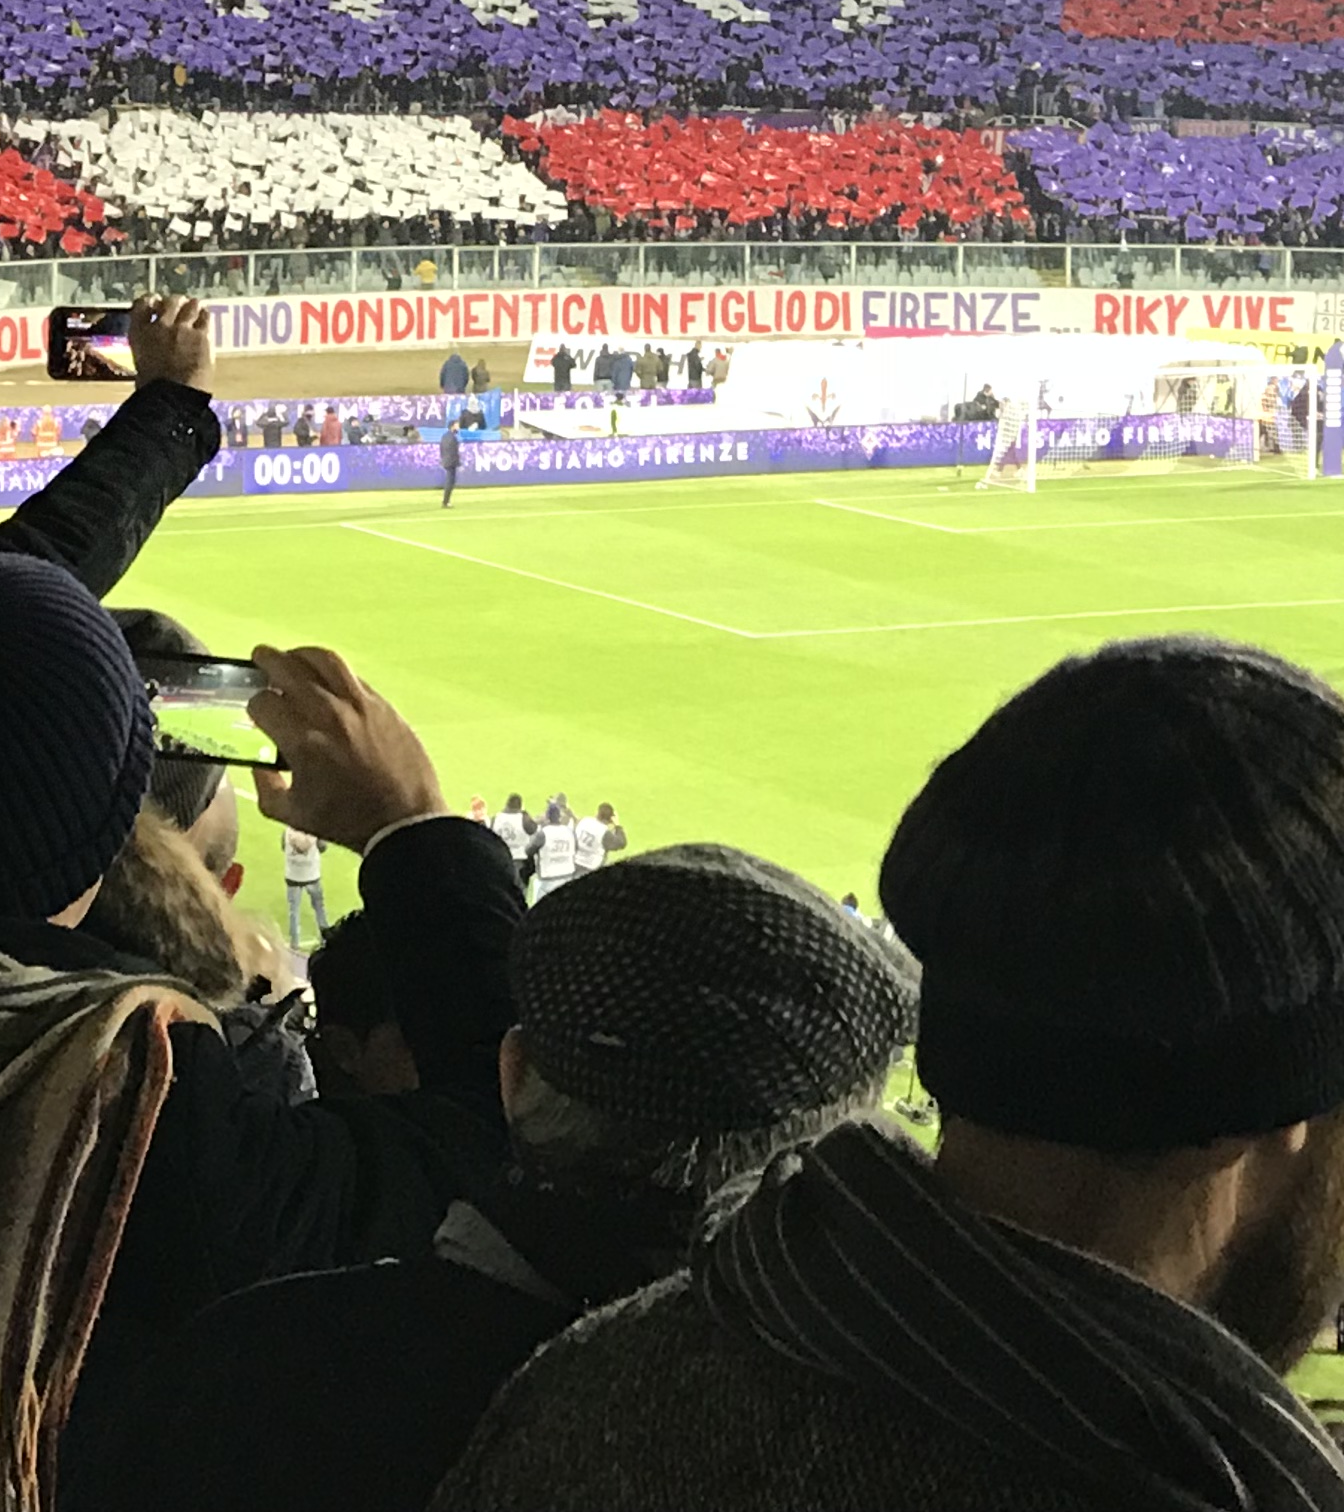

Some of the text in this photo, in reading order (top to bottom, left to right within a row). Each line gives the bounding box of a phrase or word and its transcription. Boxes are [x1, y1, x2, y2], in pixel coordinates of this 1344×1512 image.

[621, 292, 669, 335] UN
[680, 289, 807, 334] FIGLIO
[814, 291, 852, 332] DI
[1095, 294, 1189, 336] RIKY
[1202, 295, 1294, 333] VIVE
[1123, 426, 1215, 446] FIRENZE
[254, 452, 341, 486] 00:00
[474, 441, 750, 473] NOI SIAMO FIRENZE
